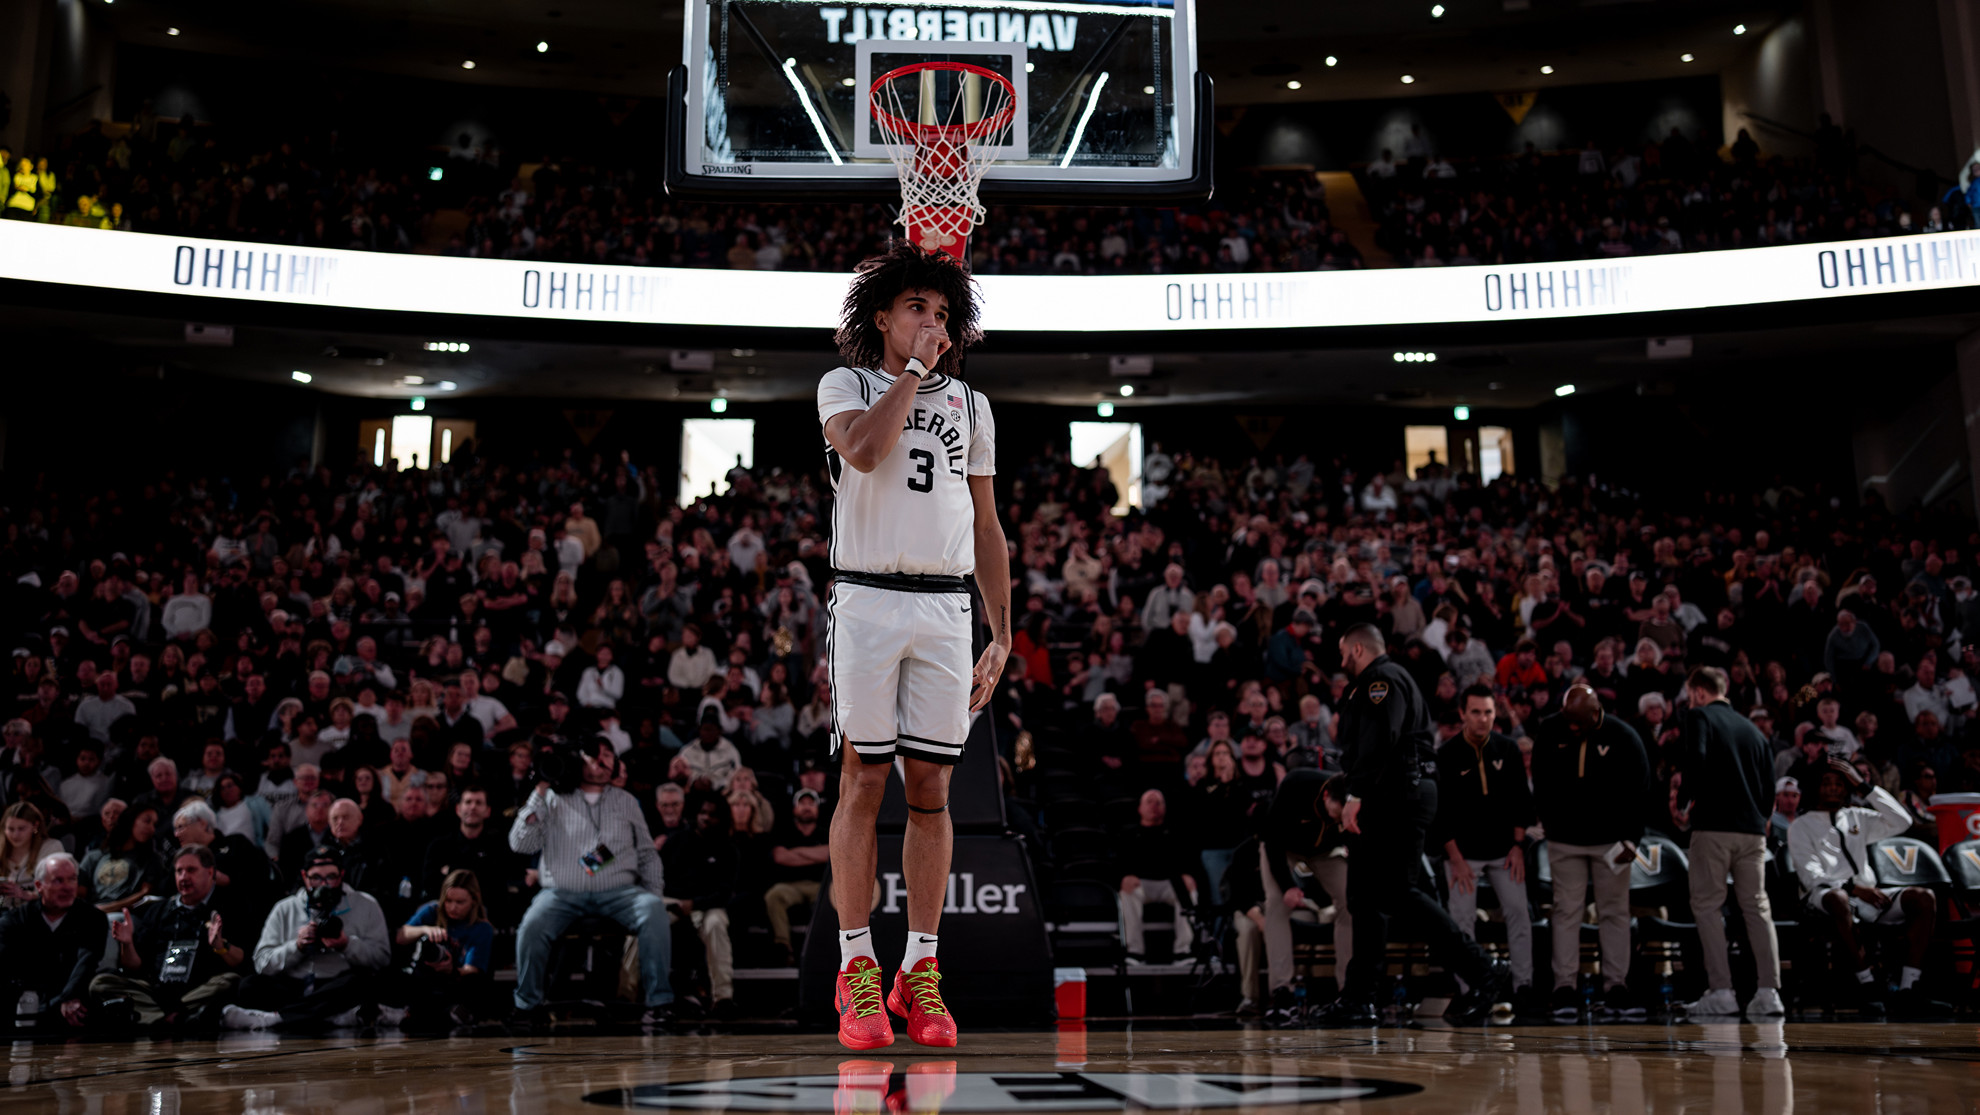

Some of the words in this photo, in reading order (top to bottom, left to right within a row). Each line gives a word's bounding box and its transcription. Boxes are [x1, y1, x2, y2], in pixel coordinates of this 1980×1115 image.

[702, 164, 752, 175] SPALDING
[907, 448, 934, 493] 3
[1880, 845, 1919, 874] V
[882, 872, 1026, 914] Hller
